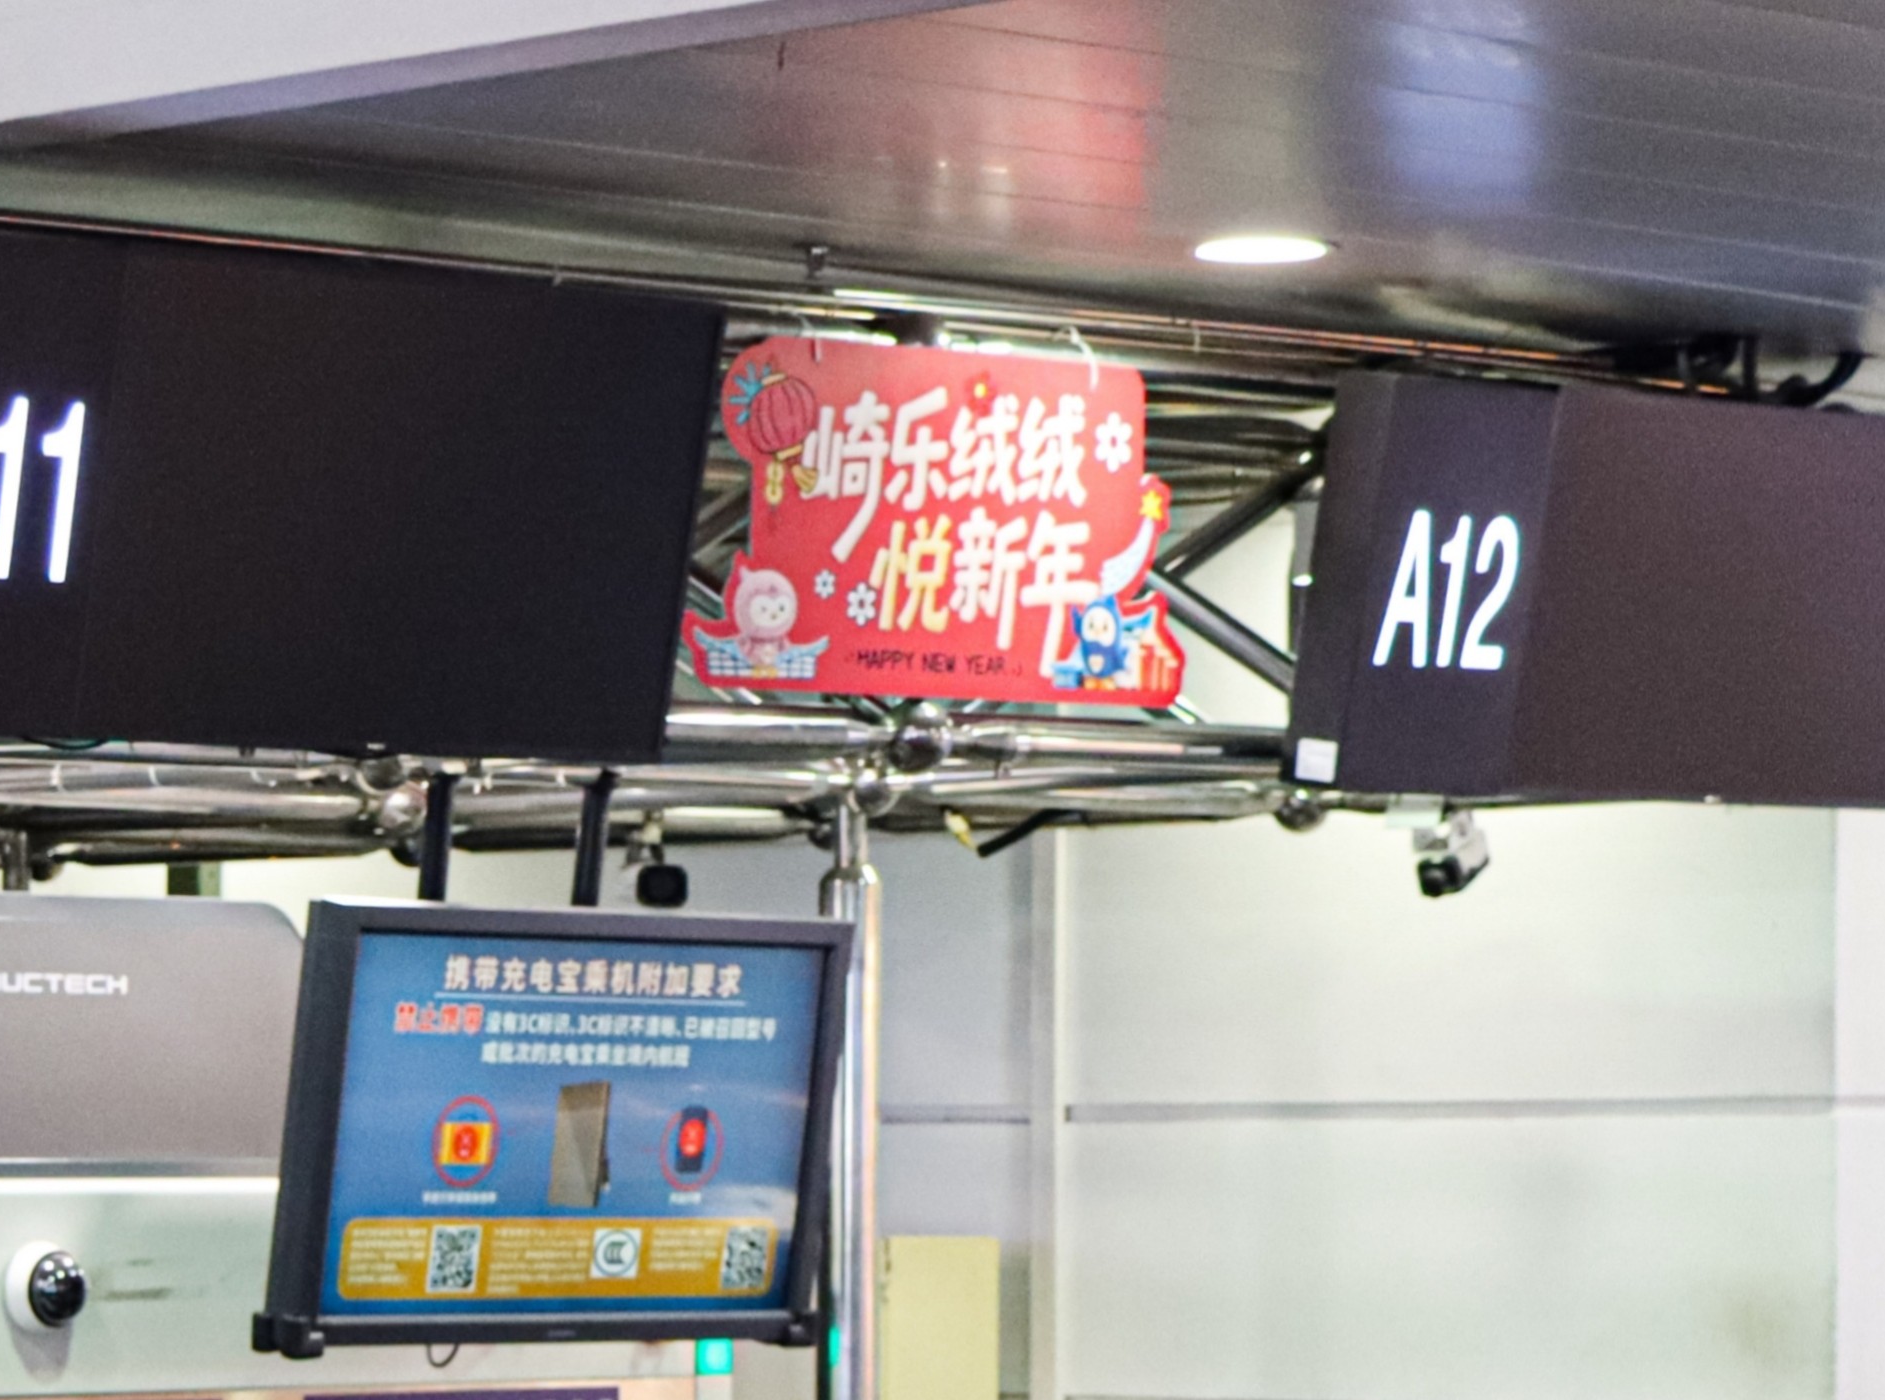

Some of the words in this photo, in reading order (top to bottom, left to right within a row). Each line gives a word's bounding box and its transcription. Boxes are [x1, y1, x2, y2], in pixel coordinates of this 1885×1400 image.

[1373, 510, 1520, 671] A12
[857, 650, 914, 670] HAPPY
[922, 653, 956, 673] NEW
[966, 653, 1006, 675] YEAR
